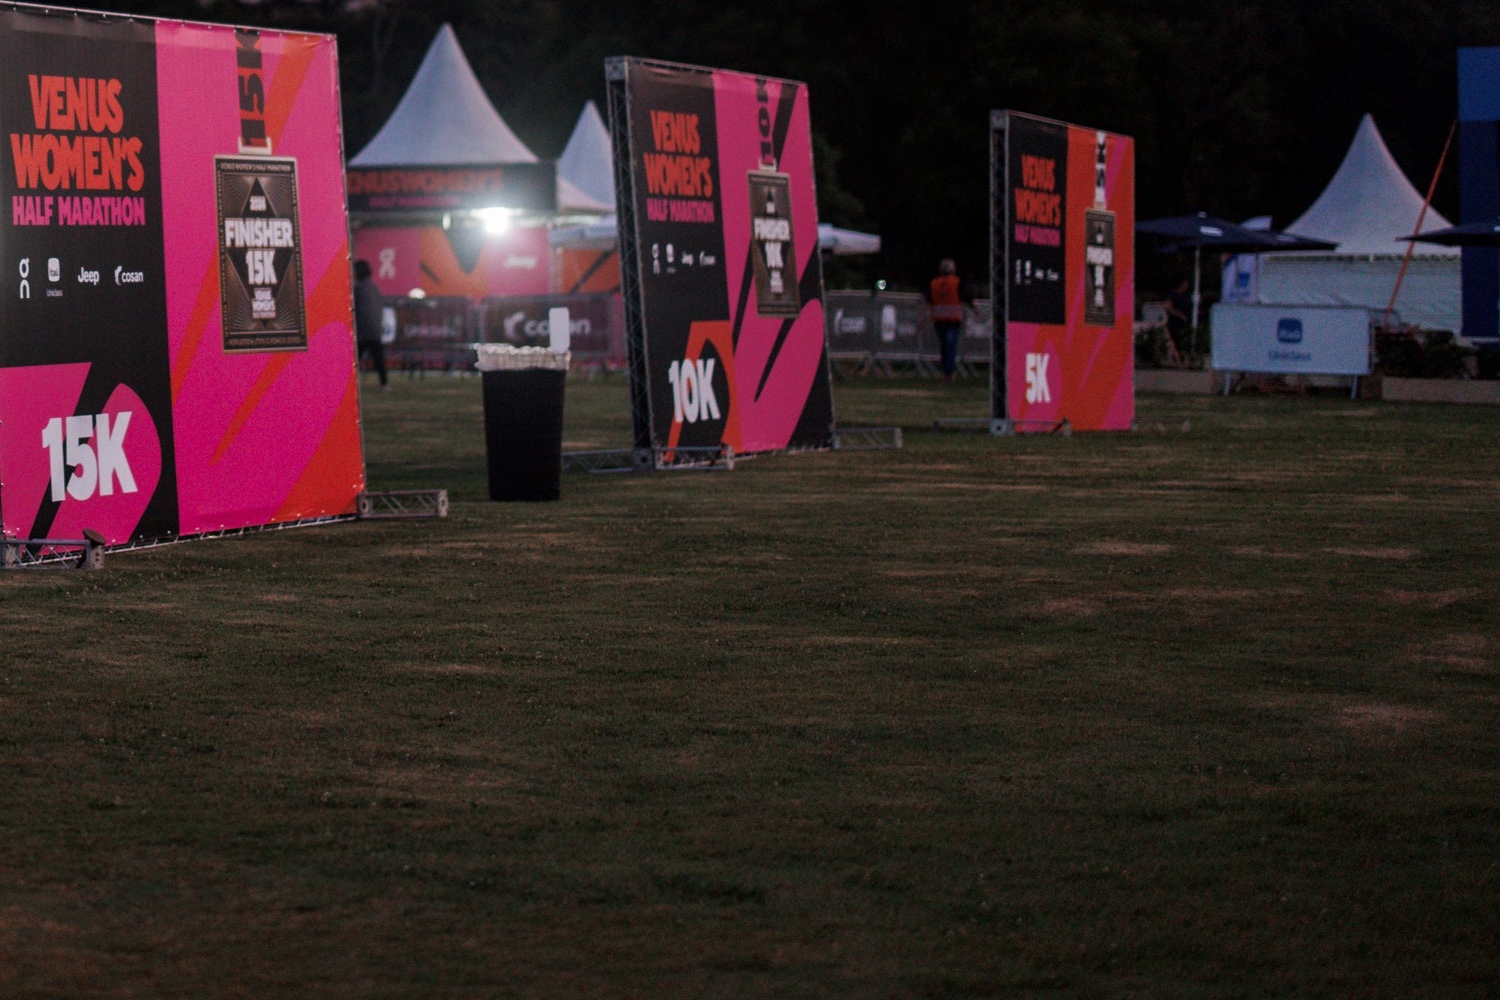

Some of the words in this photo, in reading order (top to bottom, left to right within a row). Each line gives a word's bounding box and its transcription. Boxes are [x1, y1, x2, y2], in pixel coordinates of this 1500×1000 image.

[28, 74, 124, 134] VENUS
[650, 109, 700, 155] VENUS
[10, 133, 145, 192] WOMEN'S
[643, 151, 713, 197] WOMEN'S
[12, 195, 54, 226] HALF
[58, 196, 145, 226] MARATHON
[224, 218, 294, 248] FINISHER
[78, 267, 100, 285] Jeep
[121, 271, 144, 283] cosan
[246, 248, 277, 285] 15K
[668, 358, 721, 424] 10K
[1026, 353, 1051, 404] 5K
[42, 411, 138, 502] 15K
